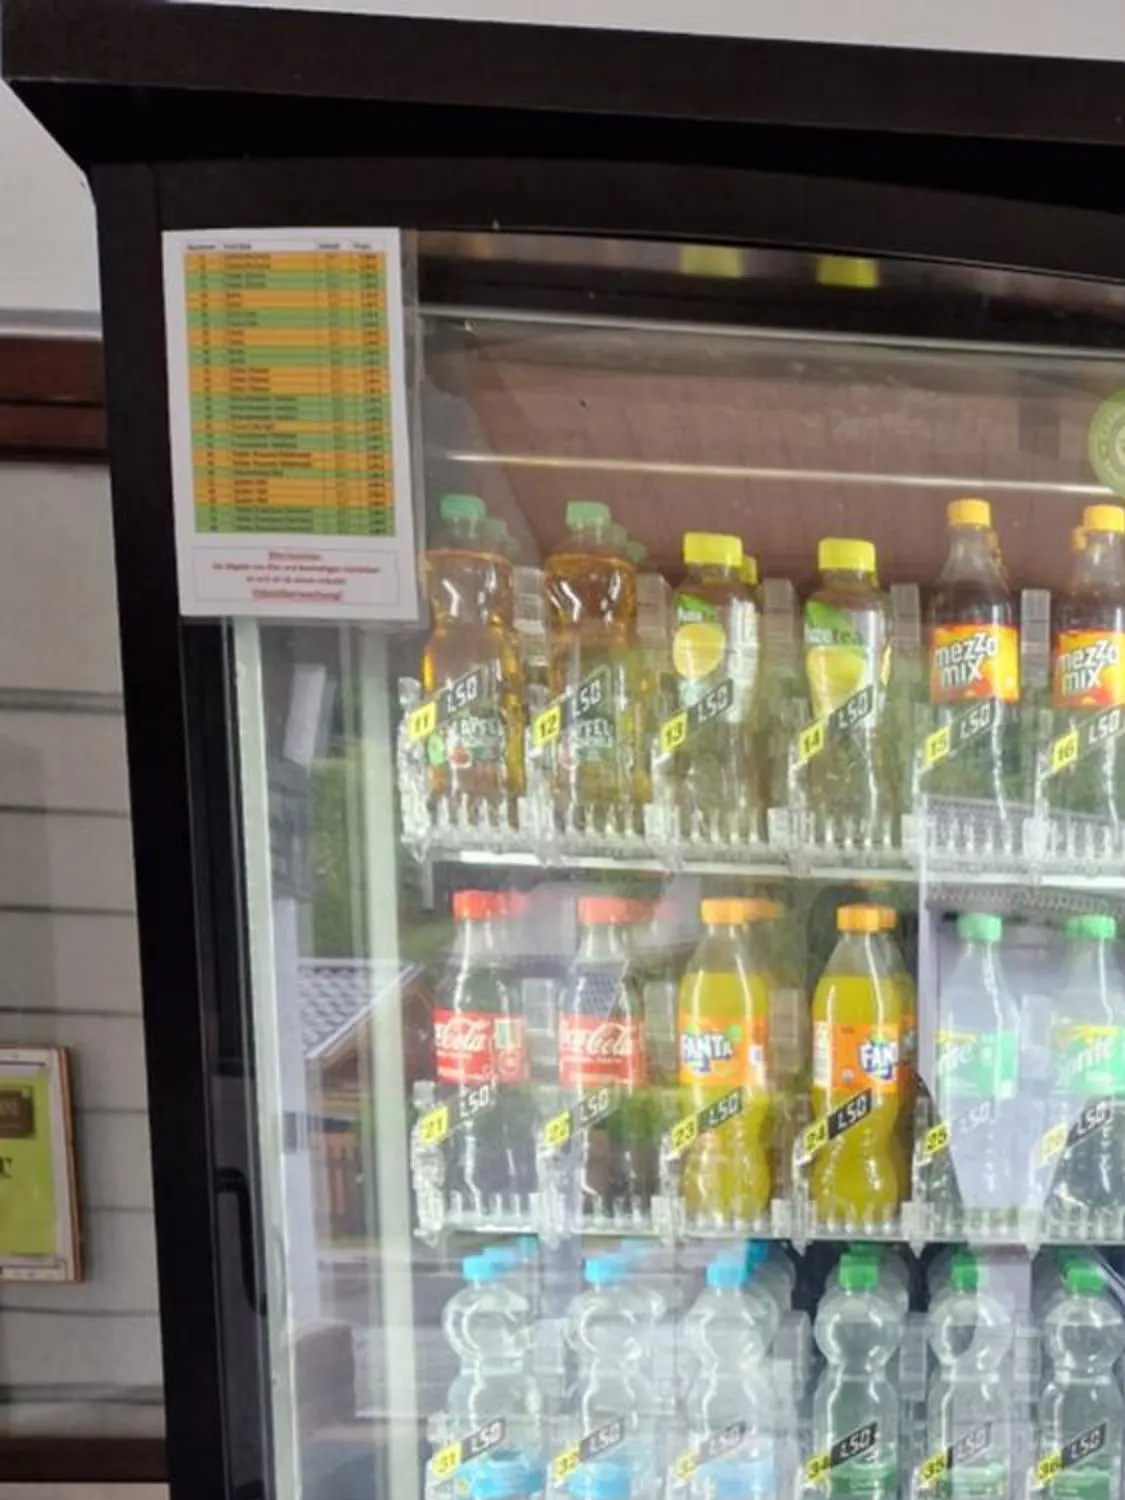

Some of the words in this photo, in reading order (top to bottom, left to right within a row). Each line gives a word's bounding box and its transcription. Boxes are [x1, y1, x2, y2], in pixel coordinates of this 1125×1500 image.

[935, 631, 1001, 667] mezzo
[1057, 639, 1121, 672] mezzo
[941, 654, 985, 689] mix
[1062, 661, 1106, 692] mix
